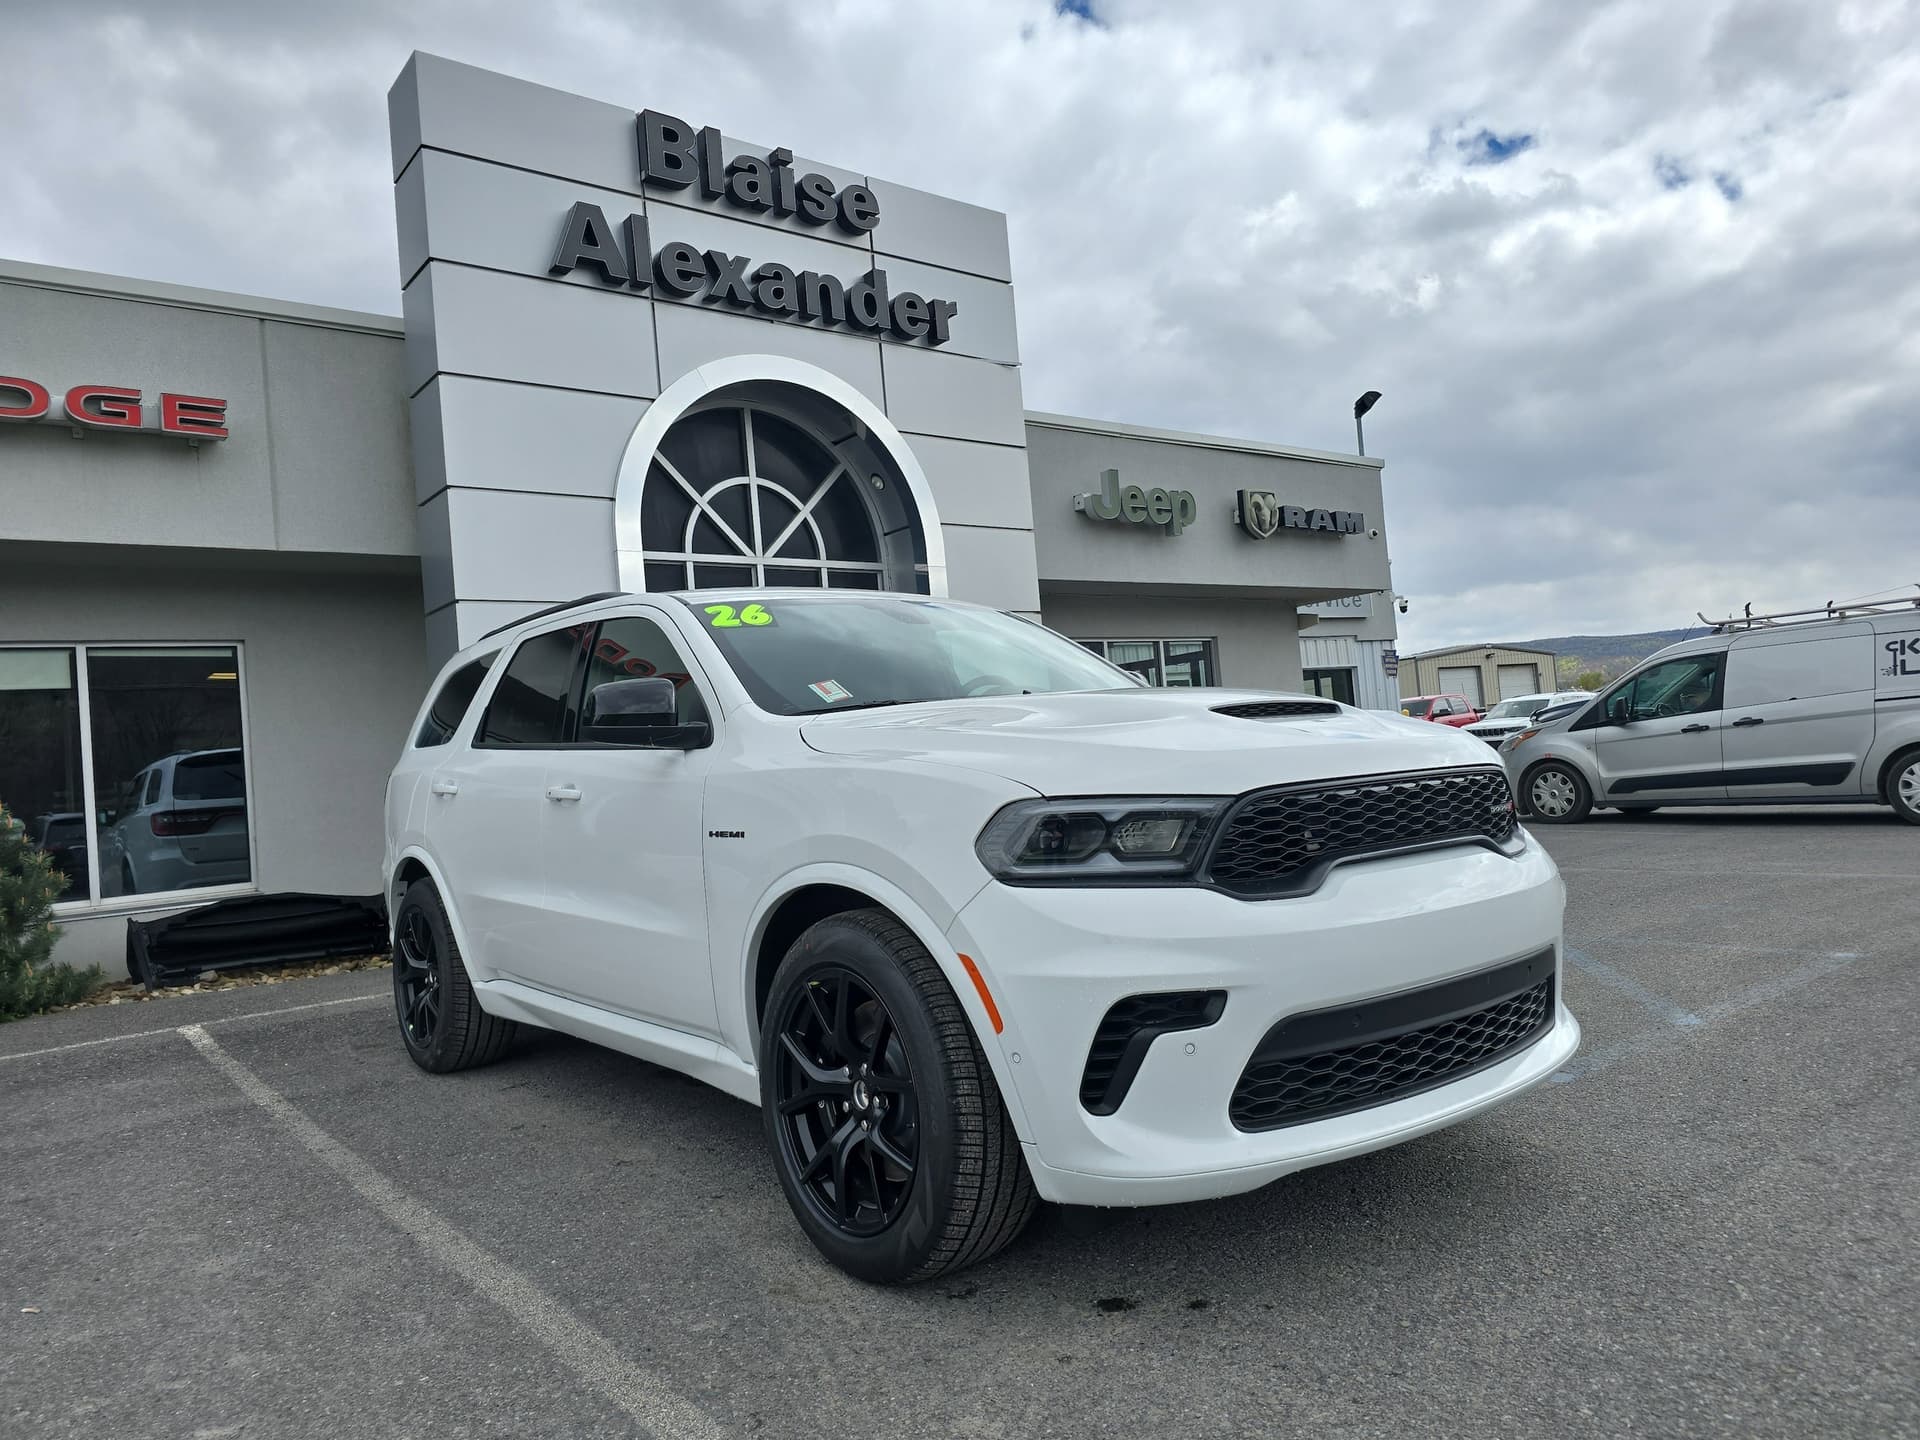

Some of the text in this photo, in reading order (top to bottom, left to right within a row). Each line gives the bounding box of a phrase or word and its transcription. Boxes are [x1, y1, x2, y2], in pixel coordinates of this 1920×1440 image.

[637, 108, 880, 235] Blaise
[549, 201, 957, 345] Alexander
[1088, 469, 1196, 536] Jeep
[1279, 505, 1364, 534] RAM
[704, 604, 773, 627] 26
[1305, 595, 1362, 608] vice
